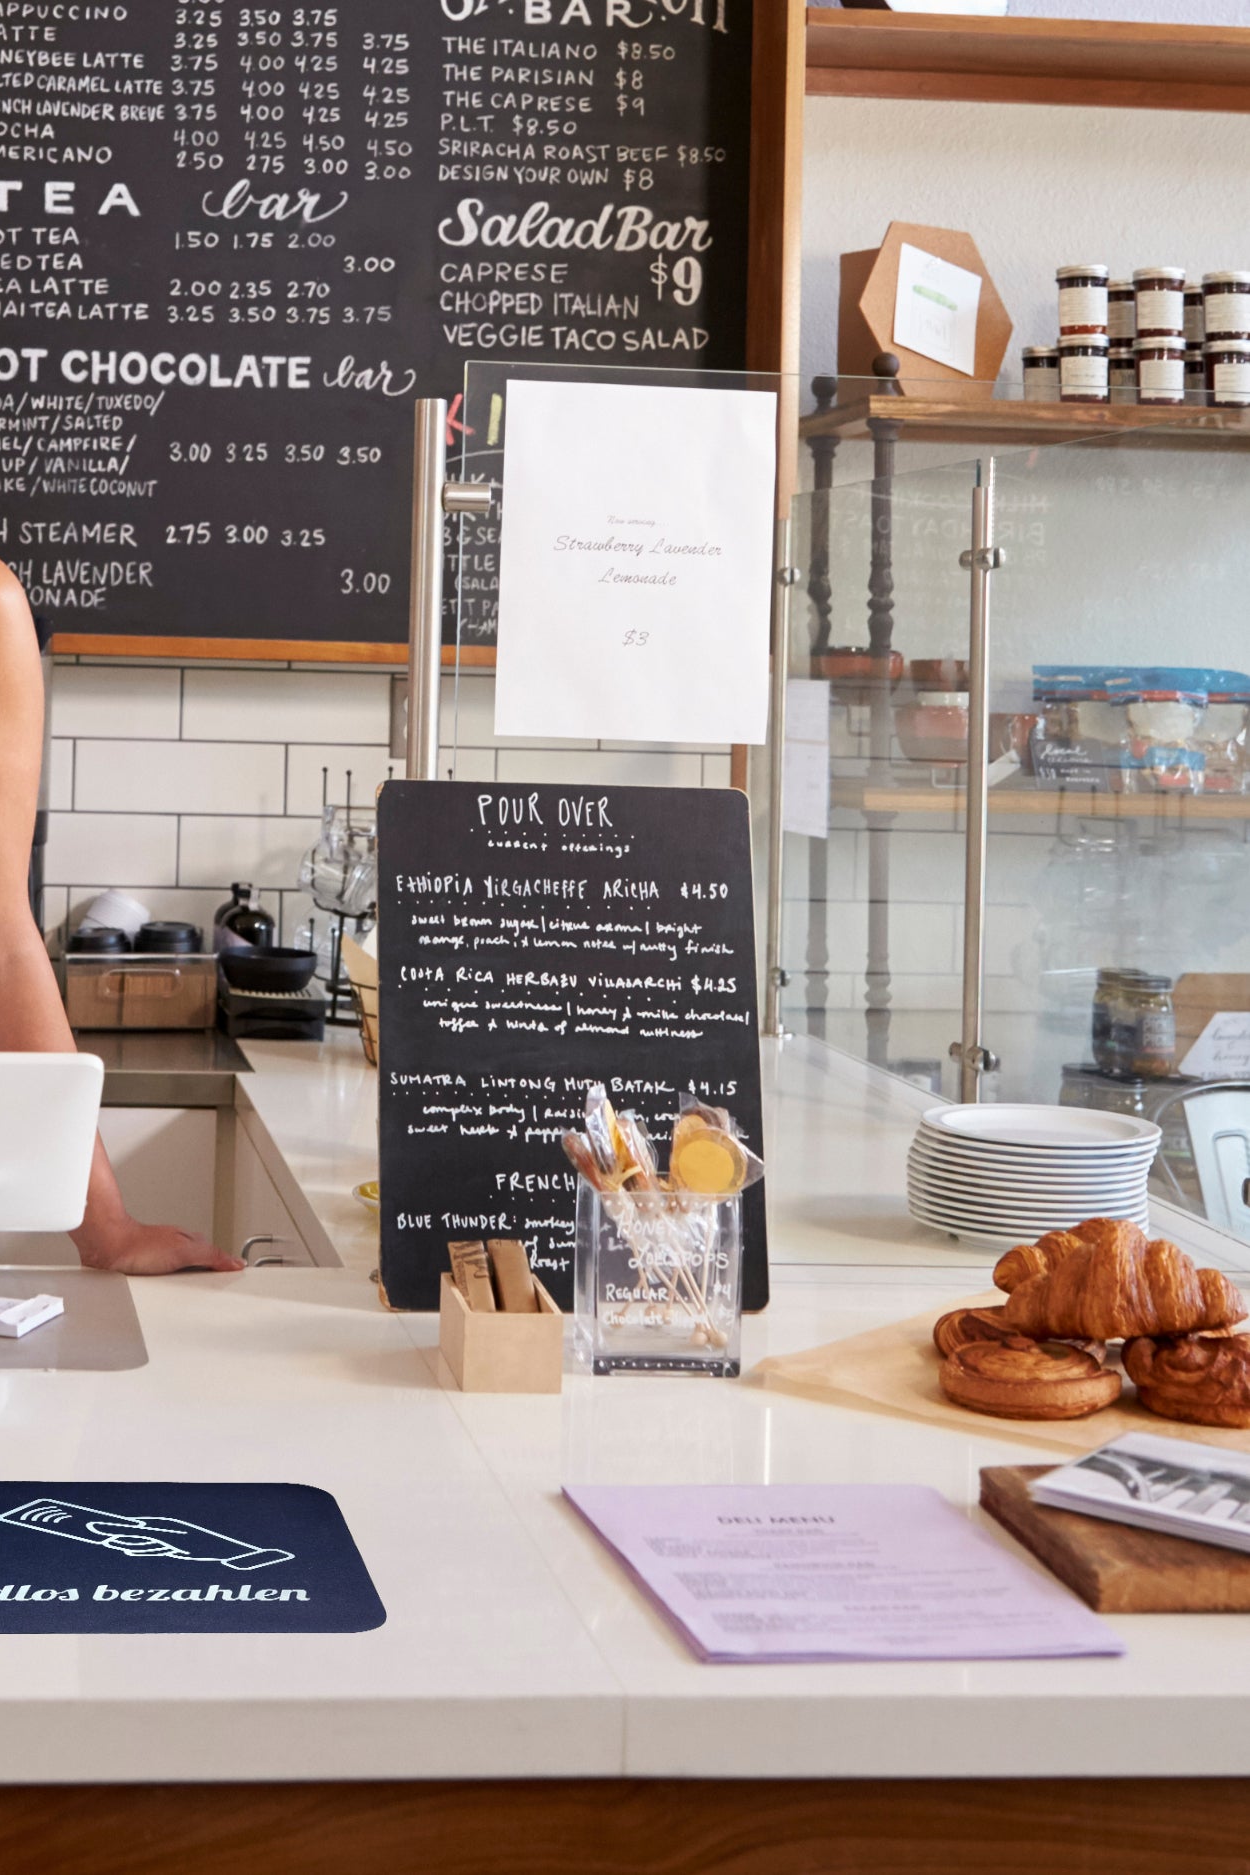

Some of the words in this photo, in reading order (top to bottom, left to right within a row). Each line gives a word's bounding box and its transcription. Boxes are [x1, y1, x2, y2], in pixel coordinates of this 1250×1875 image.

[175, 9, 222, 27] 3.25
[239, 9, 281, 27] 3.50
[292, 9, 338, 26] 3.75
[174, 32, 218, 49] 3.25
[237, 32, 281, 46] 3.50
[290, 32, 338, 48] 3.75
[363, 33, 409, 51] 3.75
[442, 36, 486, 55] THE
[494, 39, 597, 60] ITALIANO
[616, 40, 675, 61] $8.50
[83, 53, 144, 68] LATTE
[171, 54, 218, 72] 3.75
[240, 56, 285, 73] 4.00
[37, 75, 110, 93] CARAMEL
[115, 79, 163, 95] LATTE
[171, 80, 215, 96] 3.75
[442, 63, 483, 81] THE
[491, 67, 594, 86] PARISIAN
[614, 67, 643, 90] $8
[36, 102, 115, 121] LAVENDER
[121, 104, 165, 122] BREVE
[240, 105, 284, 123] 4.00
[443, 91, 483, 108] THE
[491, 92, 592, 113] CAPRESE
[616, 94, 644, 117] $9
[512, 115, 577, 136] $8.50
[174, 130, 219, 147] 4.00
[244, 131, 287, 150] 4.25
[302, 134, 345, 153] 4.50
[367, 140, 412, 158] 4.50
[438, 138, 535, 160] SRIRACHA
[544, 144, 610, 163] ROAST
[616, 146, 669, 162] BEEF
[677, 145, 726, 168] $8.50
[304, 159, 348, 175] 3.00
[365, 162, 411, 180] 3.00
[439, 165, 508, 181] DESIGN
[513, 167, 560, 184] YOUR
[567, 168, 609, 186] OWN
[623, 169, 654, 192] $8
[202, 178, 348, 223] bar
[438, 198, 614, 249] Salad
[614, 205, 713, 251] Bar
[32, 227, 79, 245] TEA
[175, 231, 219, 250] 1.50
[233, 232, 274, 249] 1.75
[288, 232, 335, 248] 2.00
[36, 253, 83, 271] TEA
[343, 256, 395, 273] 3.00
[440, 263, 568, 283] CAPRESE
[31, 276, 109, 295] LATTE
[170, 278, 221, 296] 2.00
[230, 280, 272, 299] 2.35
[287, 281, 330, 298] 2.70
[30, 301, 71, 320] TEA
[78, 303, 149, 320] LATTE
[167, 306, 214, 323] 3.25
[228, 306, 276, 323] 3.50
[286, 307, 330, 324] 3.75
[342, 306, 391, 324] 3.75
[440, 290, 542, 315] CHOPPED
[553, 293, 639, 320] ITALIAN
[443, 323, 544, 348] VEGGIE
[551, 326, 615, 351] TACO
[623, 328, 709, 351] SALAD
[60, 350, 310, 388] CHOCOLATE
[324, 356, 417, 396] bar
[169, 442, 211, 462] 3.00
[285, 444, 325, 463] 3.50
[337, 446, 381, 465] 3.50
[90, 480, 158, 497] COCONUT
[19, 522, 137, 547] STEAMER
[166, 522, 211, 544] 2.75
[225, 525, 268, 544] 3.00
[280, 529, 325, 547] 3.25
[554, 535, 644, 556] Strawberry
[649, 538, 722, 557] Lavender
[42, 559, 154, 587] LAVENDER
[341, 569, 392, 594] 3.00
[598, 567, 677, 586] Lemonade
[622, 629, 649, 646] $3
[478, 792, 543, 825] POUR
[559, 796, 613, 827] OVER
[681, 882, 728, 899] $4.50
[507, 972, 577, 988] HERBAZU
[691, 974, 736, 995] $4.25
[391, 1072, 466, 1086] SUMATRA
[611, 1077, 675, 1094] BATAK
[688, 1079, 737, 1095] $4.15
[495, 1172, 575, 1192] FRENCH
[397, 1212, 431, 1229] BLUE
[92, 1584, 310, 1601] bezahlen
